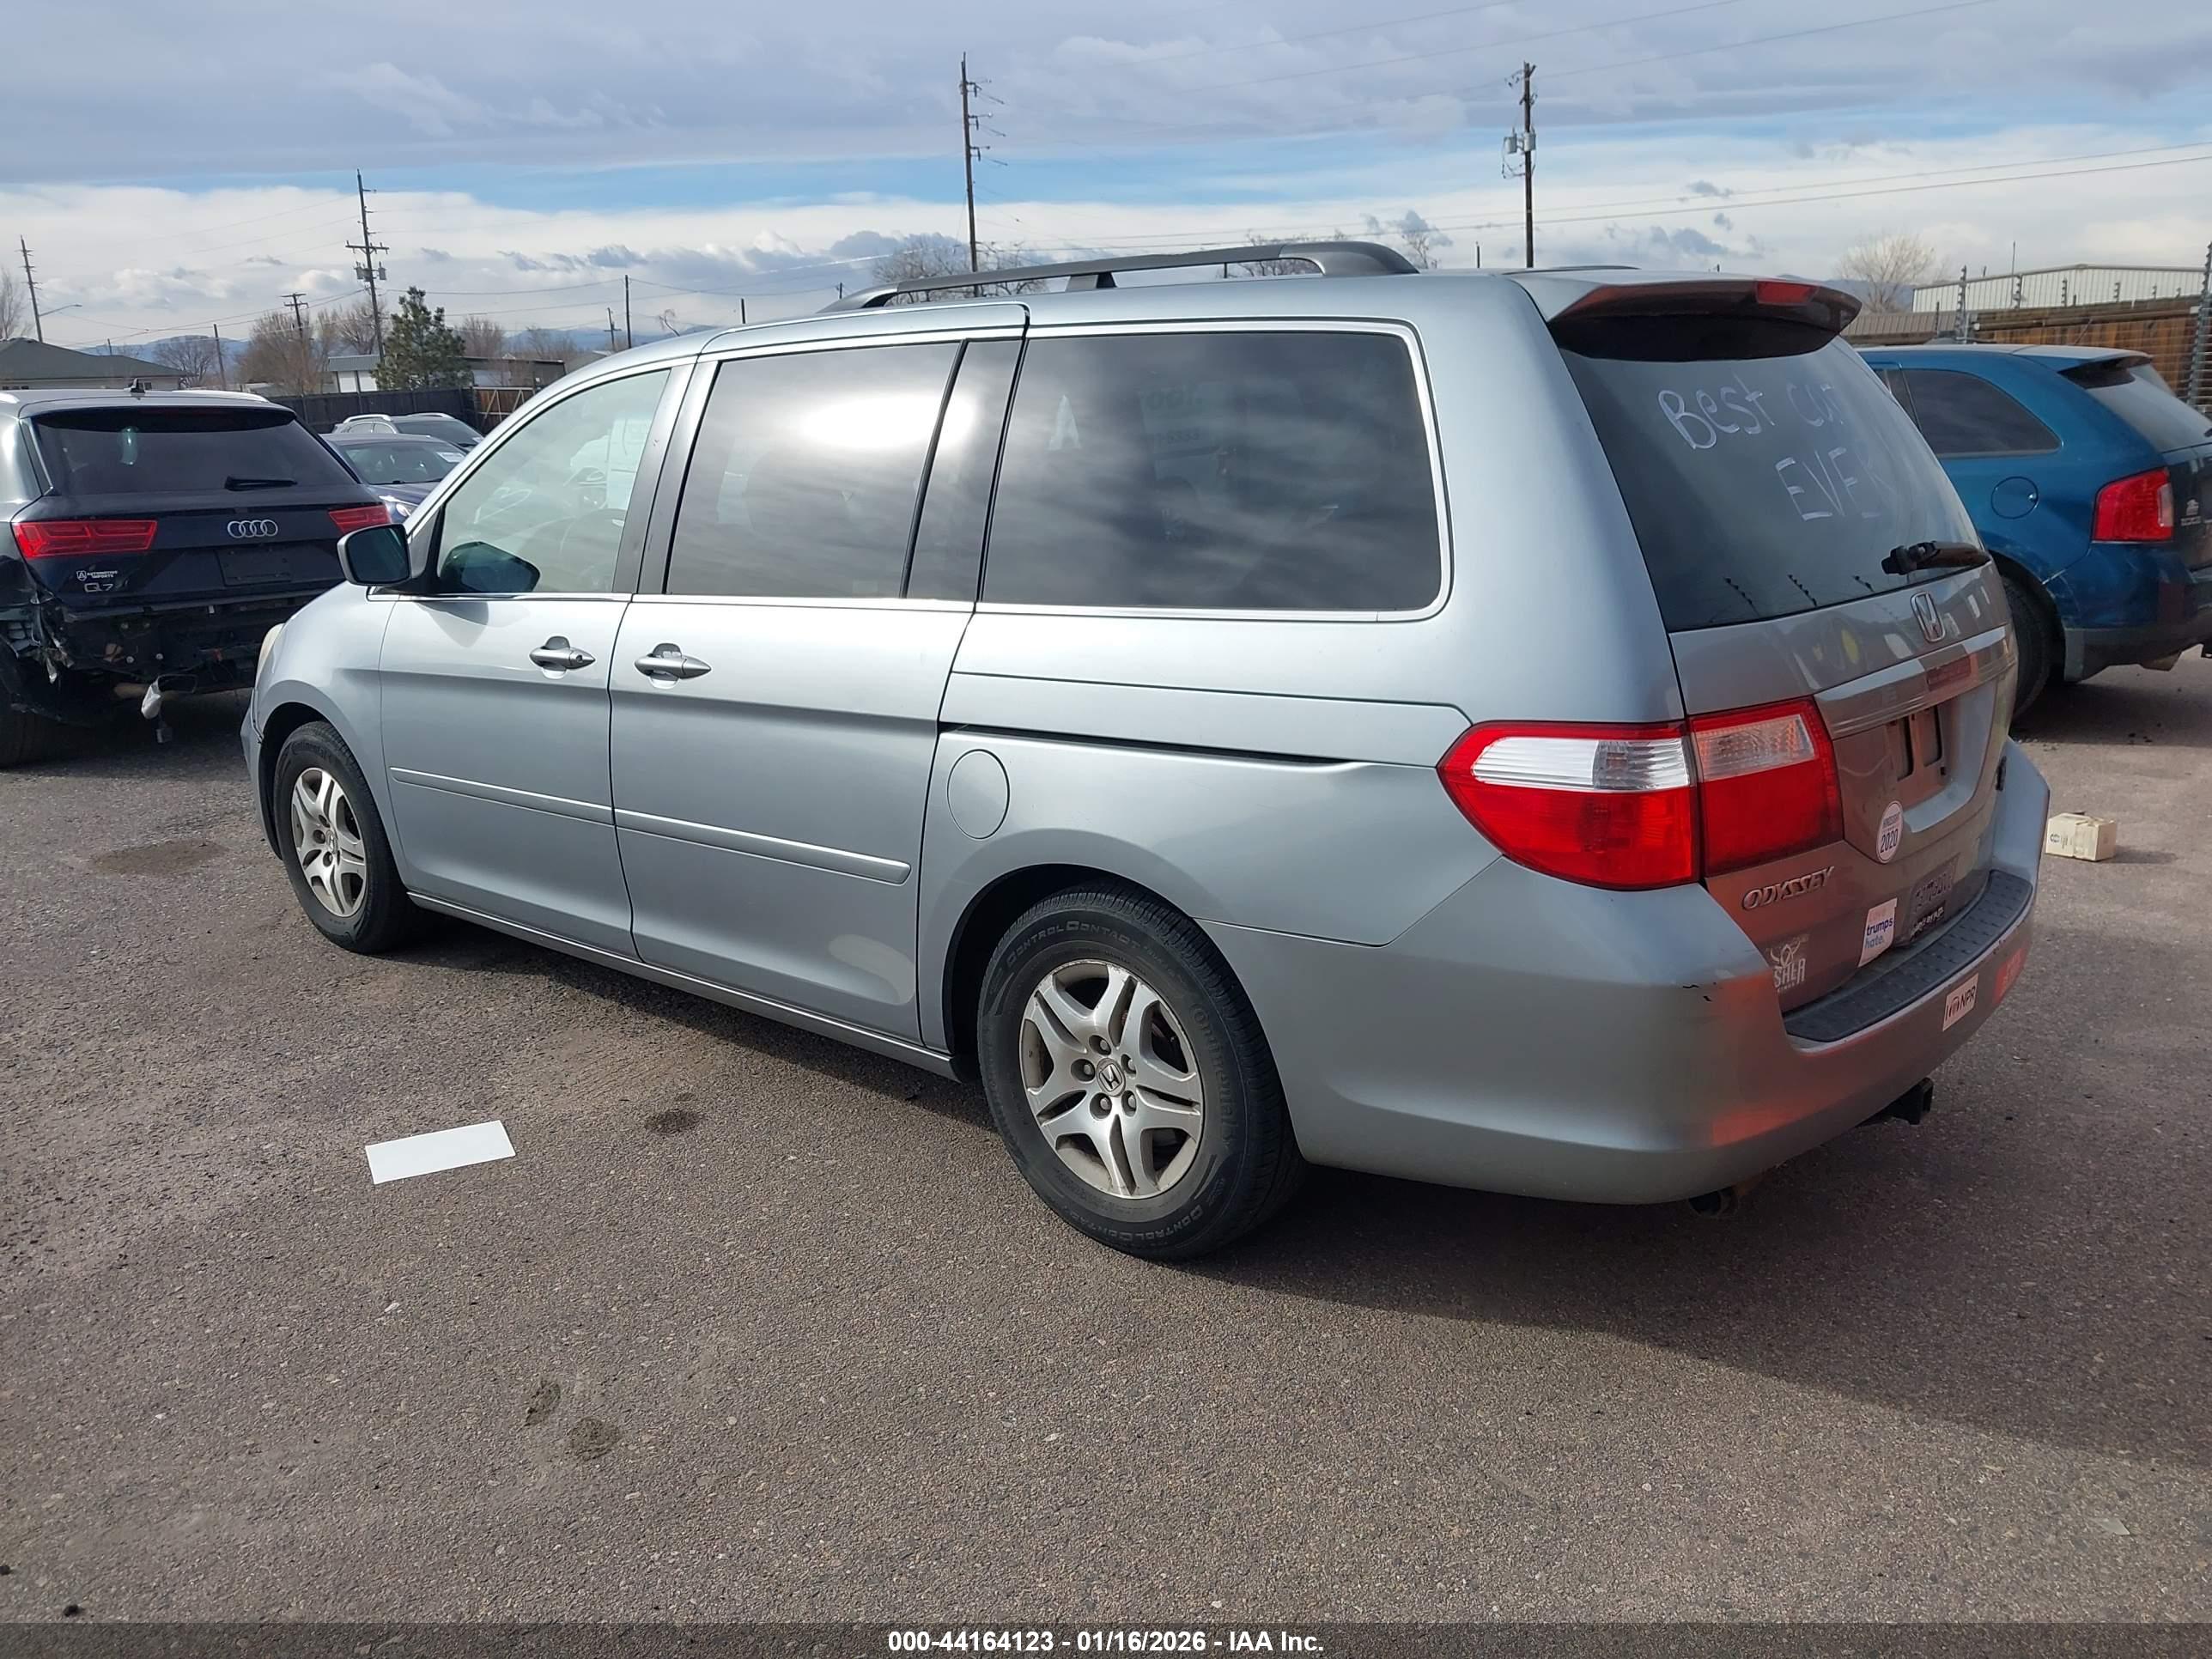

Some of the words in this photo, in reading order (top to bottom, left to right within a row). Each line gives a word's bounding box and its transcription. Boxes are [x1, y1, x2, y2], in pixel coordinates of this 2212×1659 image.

[84, 582, 113, 592] Q7
[1880, 829, 1899, 854] 2020
[1741, 866, 1835, 910] ODYSSEY
[1866, 917, 1893, 936] trumps
